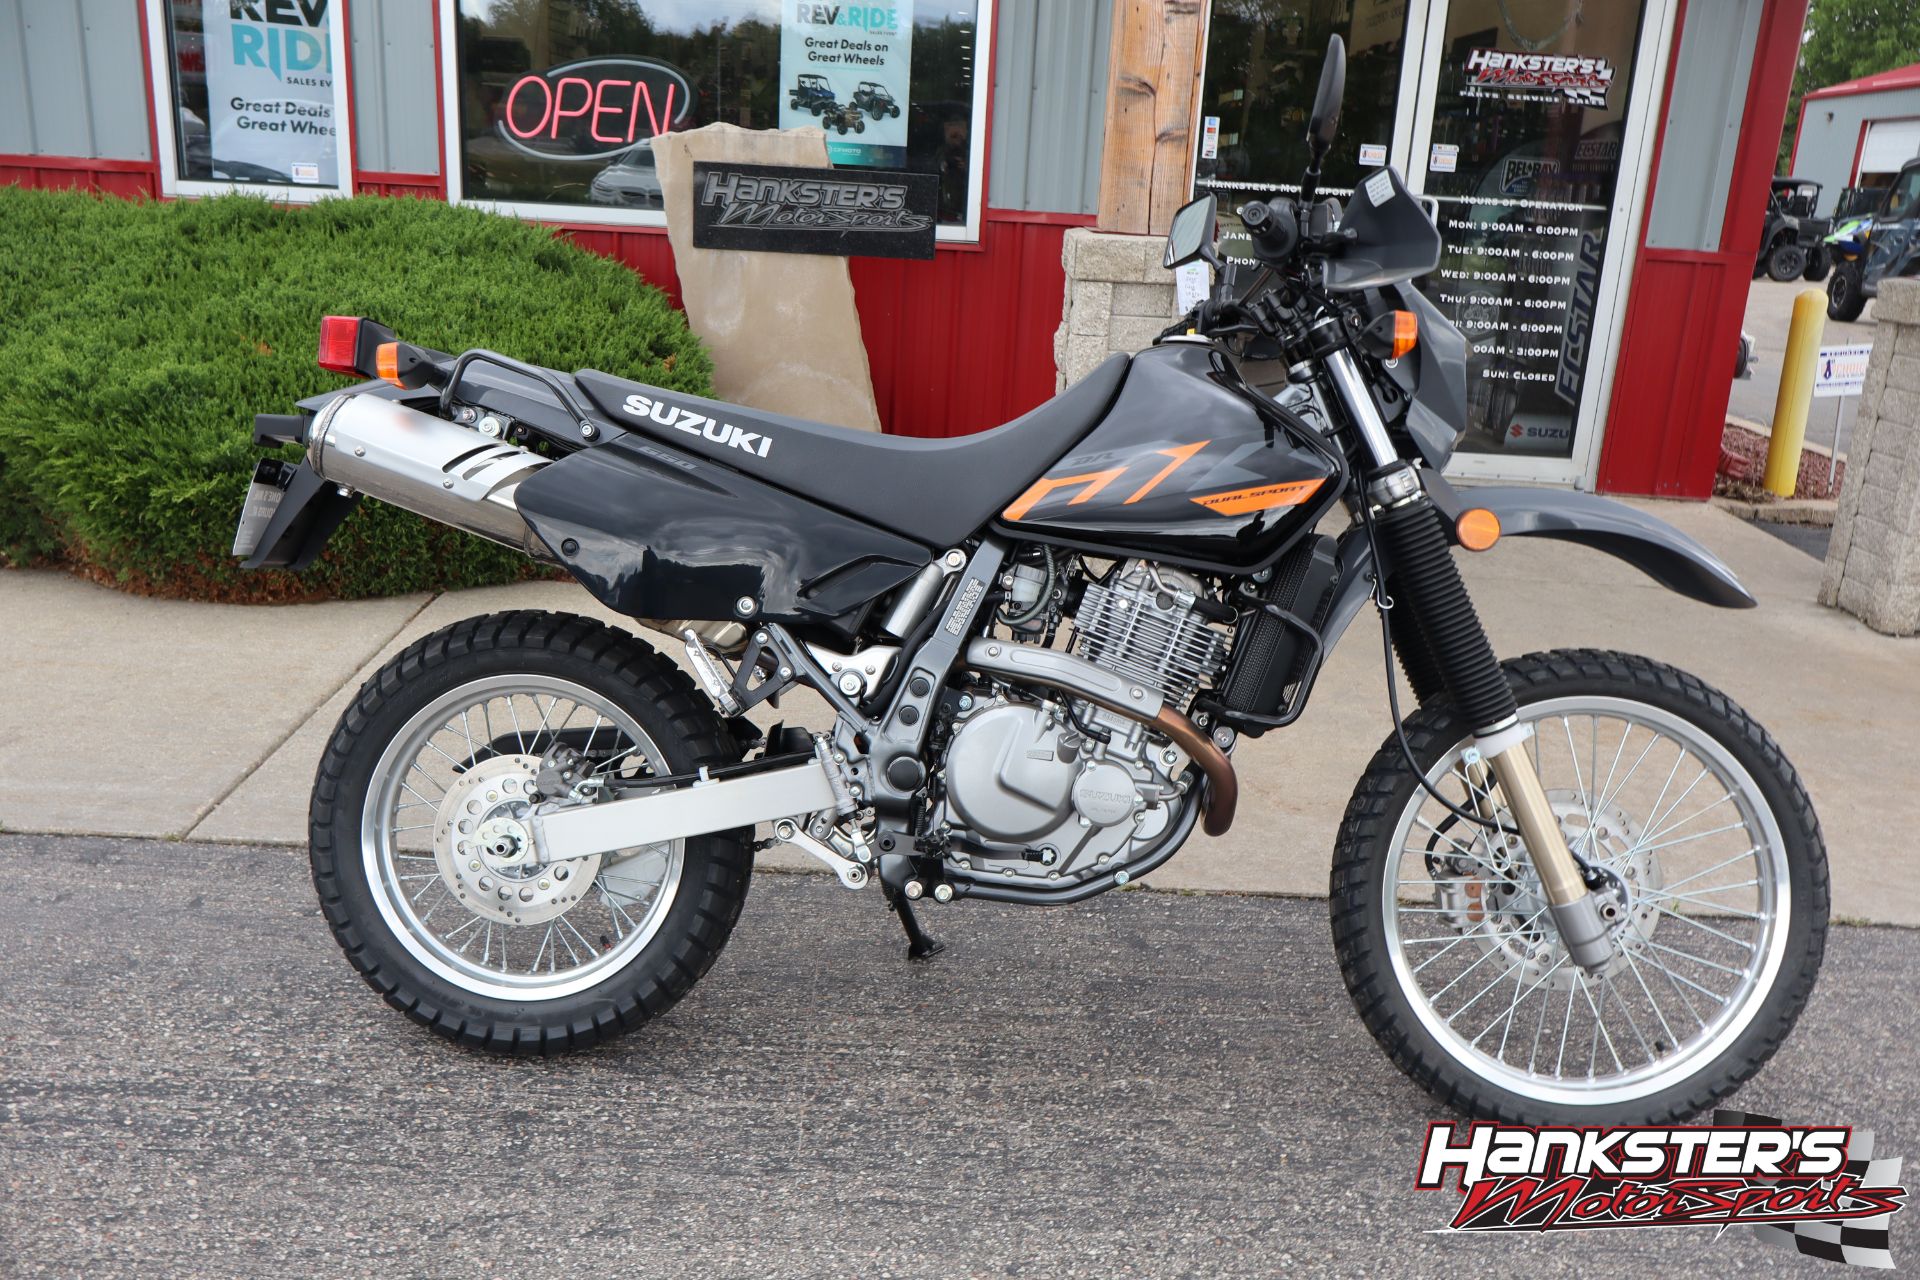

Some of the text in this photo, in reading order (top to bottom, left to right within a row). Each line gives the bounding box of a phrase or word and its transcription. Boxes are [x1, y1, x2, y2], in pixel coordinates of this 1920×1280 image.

[804, 37, 889, 52] Great Deals on
[808, 51, 885, 66] Great Wheels
[286, 76, 317, 87] SALES
[1459, 90, 1499, 99] PARTS
[1507, 93, 1560, 103] SERVICE
[230, 97, 331, 119] Great Deals
[506, 75, 675, 143] OPEN
[236, 116, 337, 137] Great Whee
[1207, 180, 1276, 193] HANKSTER'S
[1460, 195, 1583, 212] HOURS OF OPERATION
[1448, 219, 1477, 231] MON:
[1480, 221, 1524, 233] 9:00AM
[1535, 225, 1579, 237] 6:00PM
[1223, 231, 1252, 241] JANE
[1447, 244, 1473, 255] TUE:
[1477, 247, 1520, 258] 9:00AM
[1531, 250, 1574, 261] 6:00PM
[1226, 255, 1256, 266] PHON
[1440, 269, 1469, 280] WED:
[1473, 271, 1516, 283] 9:00AM
[1528, 274, 1571, 286] 6:00PM
[1440, 293, 1466, 304] THU:
[1469, 295, 1513, 307] 9:00AM
[1524, 298, 1567, 310] 6:00PM
[1466, 320, 1509, 331] 9:00AM
[1520, 323, 1563, 334] 6:00PM
[1473, 344, 1505, 355] 00AM
[1516, 347, 1559, 358] 3:00PM
[1482, 369, 1555, 382] SUN: CLOSED
[622, 394, 773, 458] SUZUKI
[1526, 427, 1570, 439] SUZU
[1202, 485, 1306, 505] DUAL SPORT
